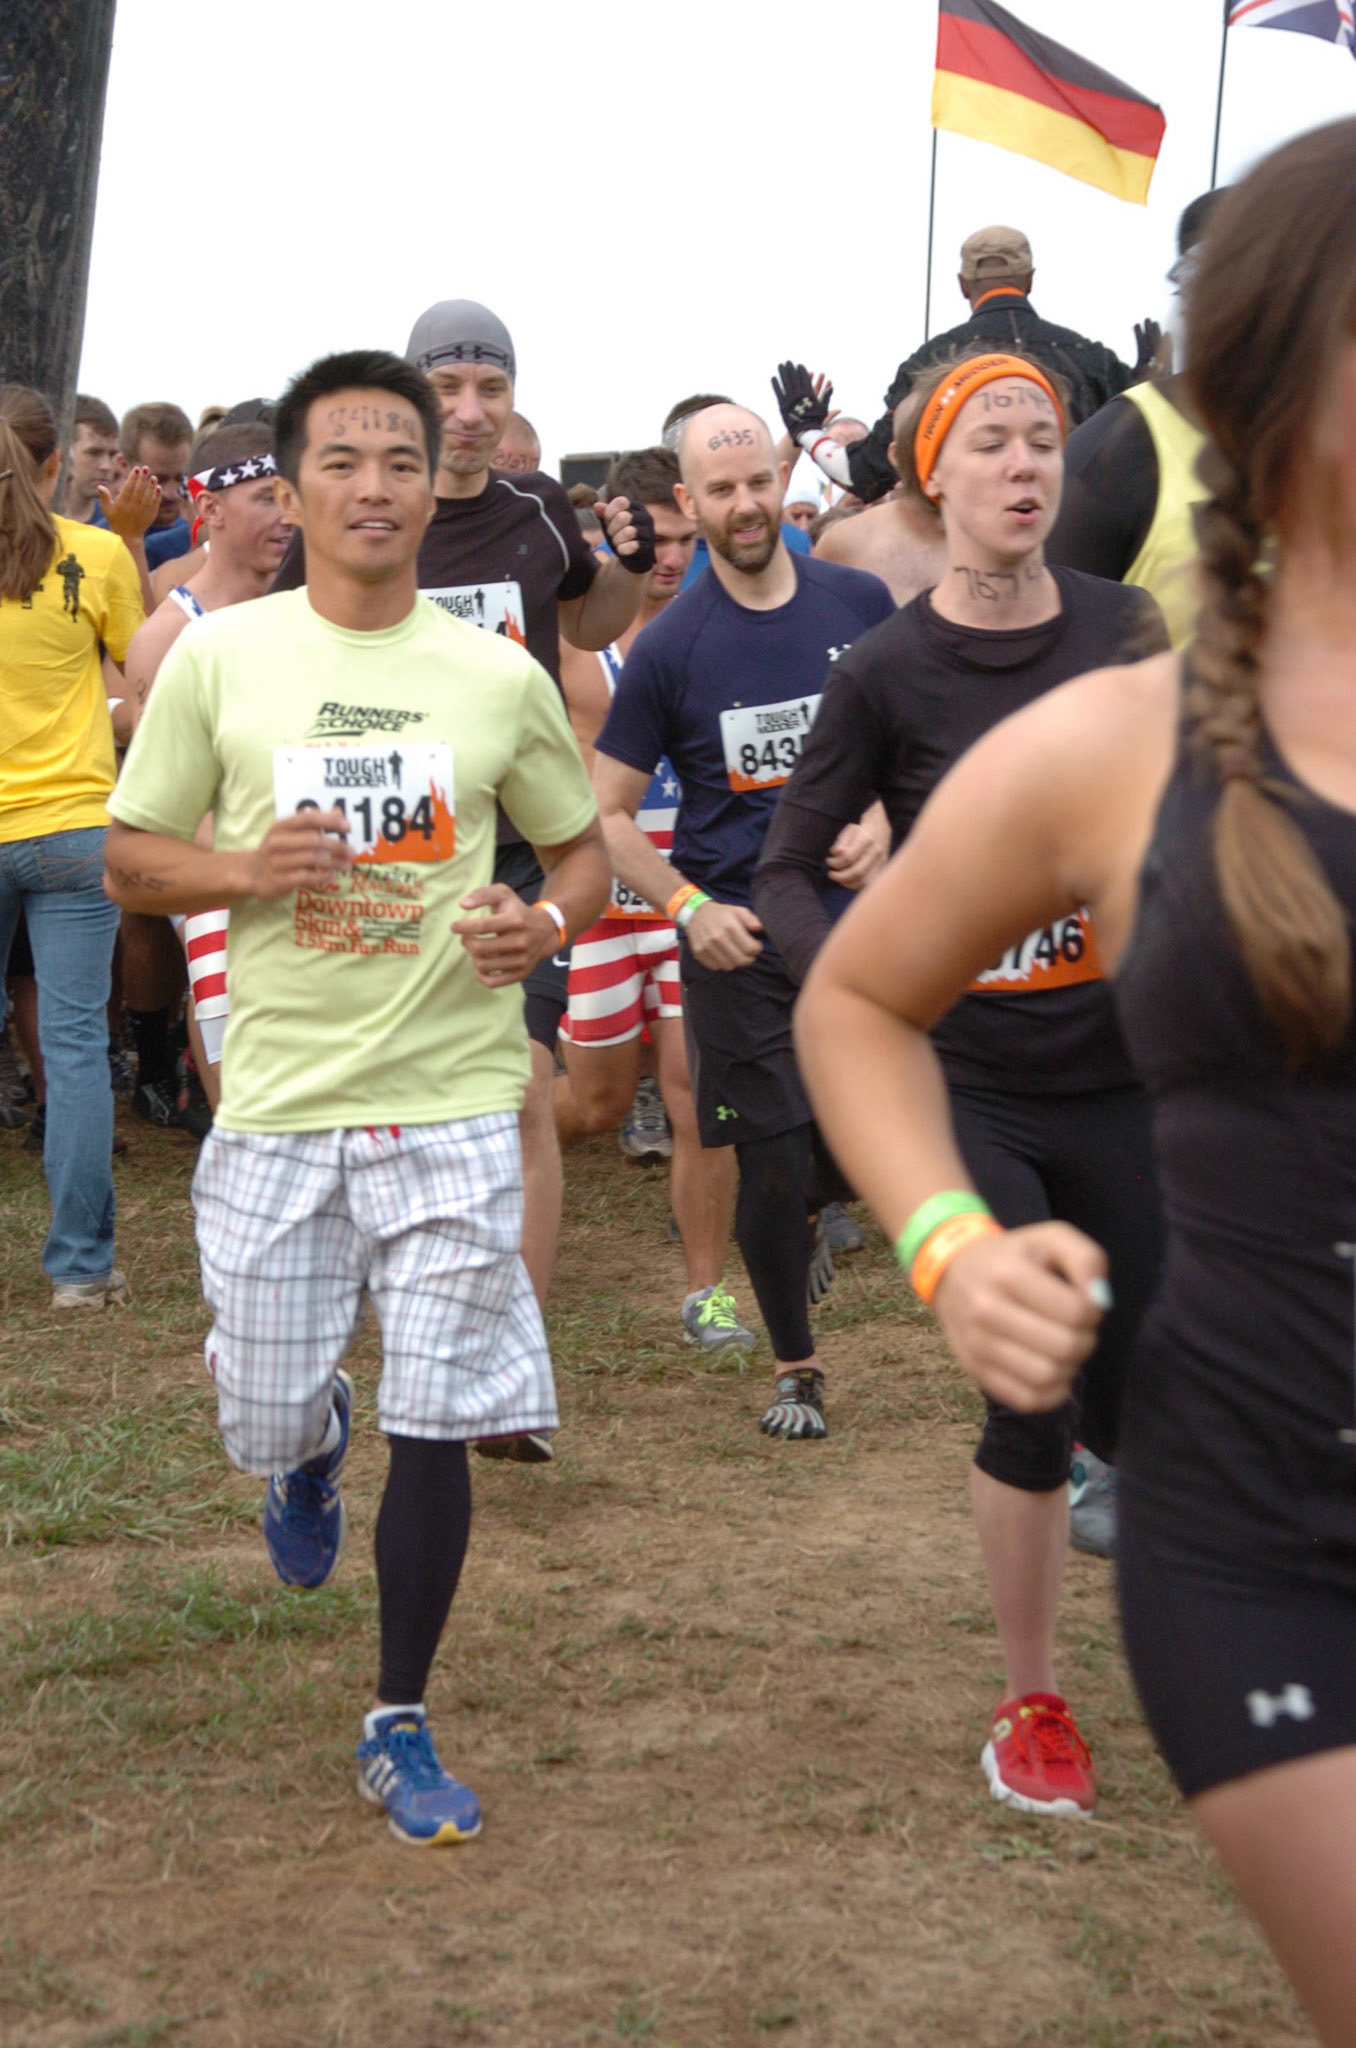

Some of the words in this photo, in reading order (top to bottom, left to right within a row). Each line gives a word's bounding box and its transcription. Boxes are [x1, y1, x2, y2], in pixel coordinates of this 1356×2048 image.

[328, 717, 405, 733] CHOICE
[740, 737, 798, 776] 843
[323, 757, 385, 776] TOUGH
[324, 775, 388, 788] MUDDER
[297, 888, 424, 921] Downtown
[384, 938, 420, 956] Run
